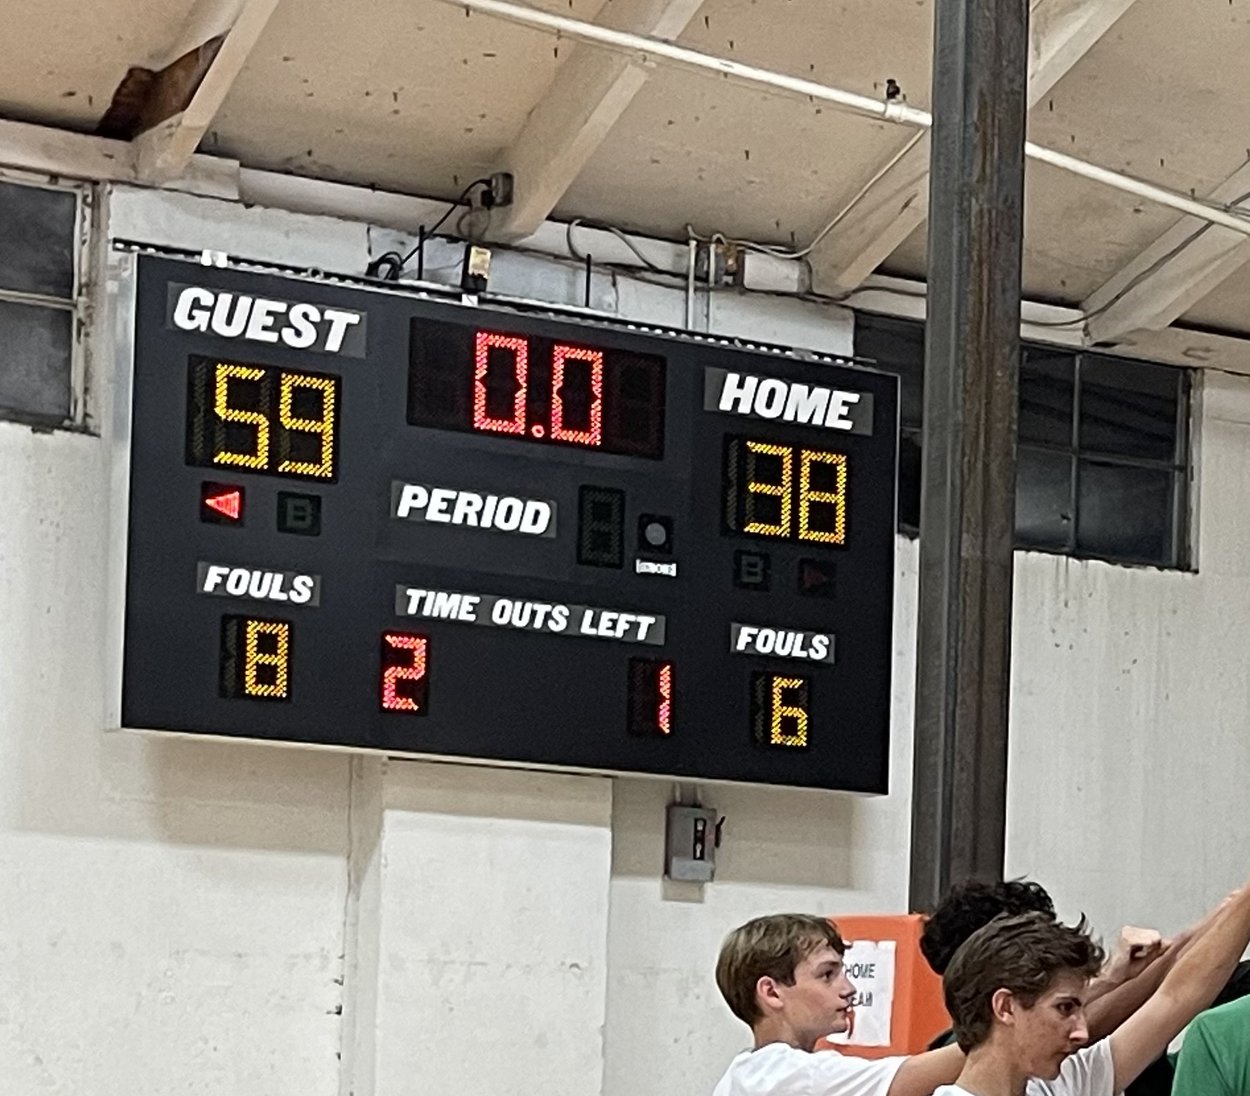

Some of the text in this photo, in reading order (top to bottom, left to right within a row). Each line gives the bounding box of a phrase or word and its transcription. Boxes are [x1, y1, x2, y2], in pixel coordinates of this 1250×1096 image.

[173, 287, 360, 352] GUEST
[213, 363, 336, 478] 59
[473, 331, 603, 446] 0.0
[719, 372, 860, 431] HOME
[397, 484, 551, 535] PERIOD
[743, 440, 848, 545] 38
[203, 565, 314, 604] FOULS
[406, 588, 656, 641] TIME OUTS LEFT
[245, 620, 289, 698] 8
[382, 634, 427, 711] 2
[736, 626, 830, 660] FOULS
[659, 664, 671, 735] 1
[770, 676, 808, 747] 6
